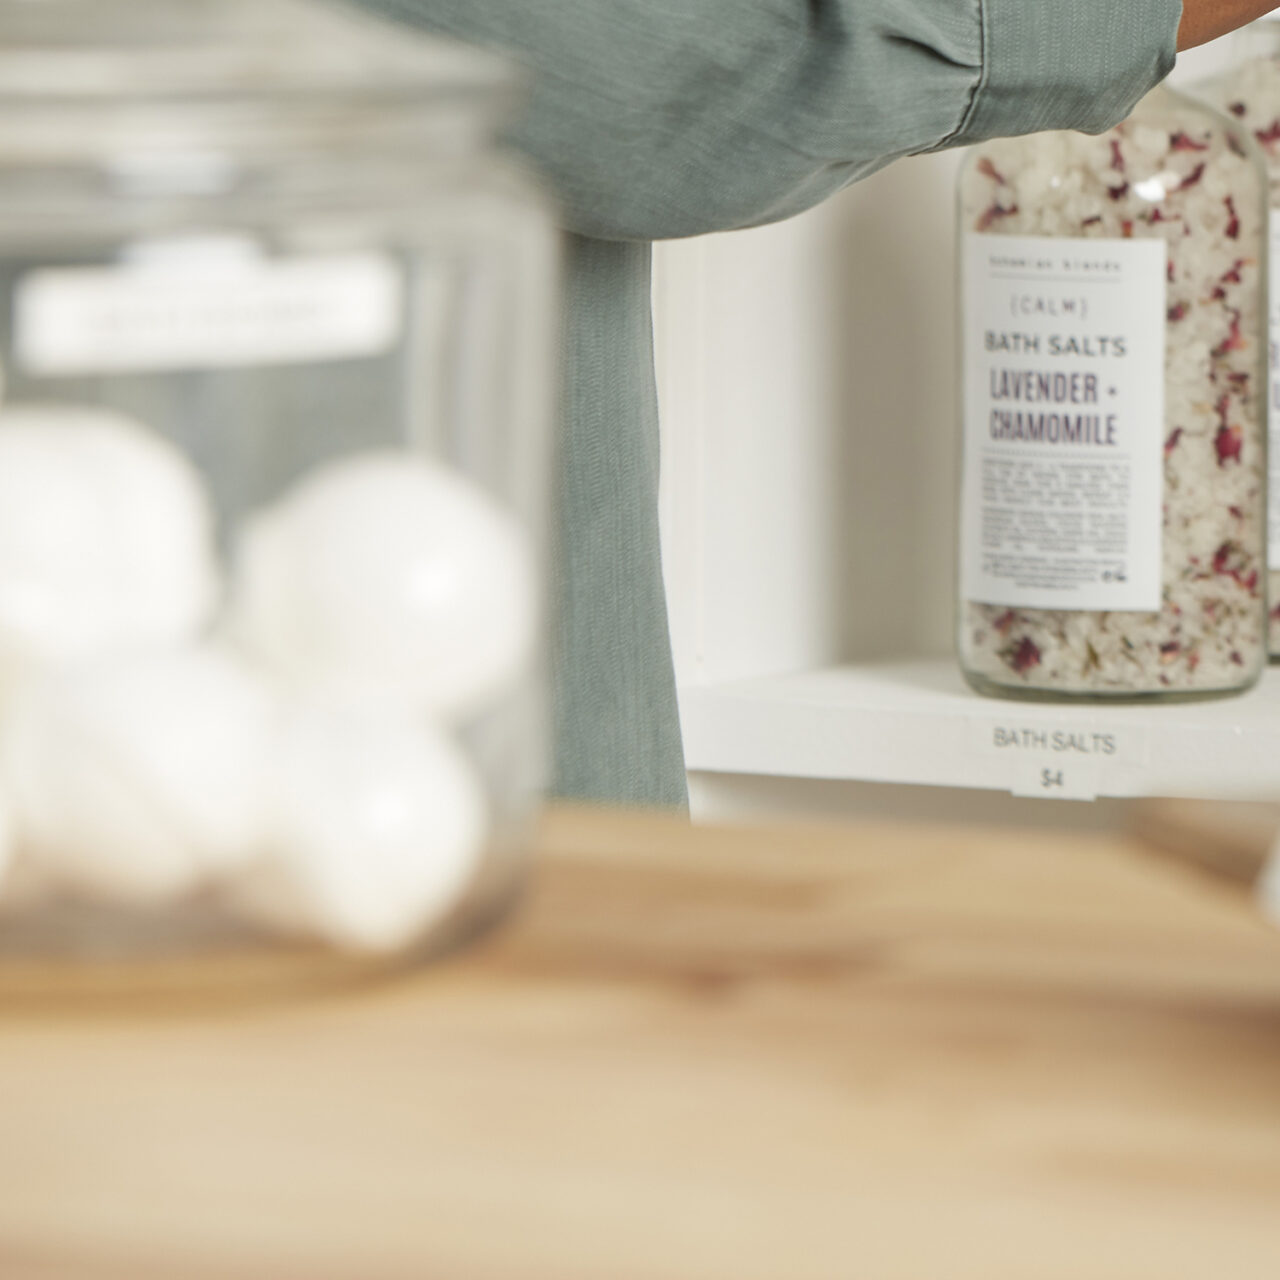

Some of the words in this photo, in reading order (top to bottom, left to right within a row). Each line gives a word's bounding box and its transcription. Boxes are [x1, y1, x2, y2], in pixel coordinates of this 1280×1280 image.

[985, 330, 1039, 354] BATH
[1048, 333, 1127, 357] SALTS
[990, 368, 1098, 404] LAVENDER
[990, 408, 1118, 446] CHAMOMILE
[992, 726, 1048, 750] BATH
[1051, 730, 1117, 755] SALTS
[1040, 766, 1065, 788] $4
